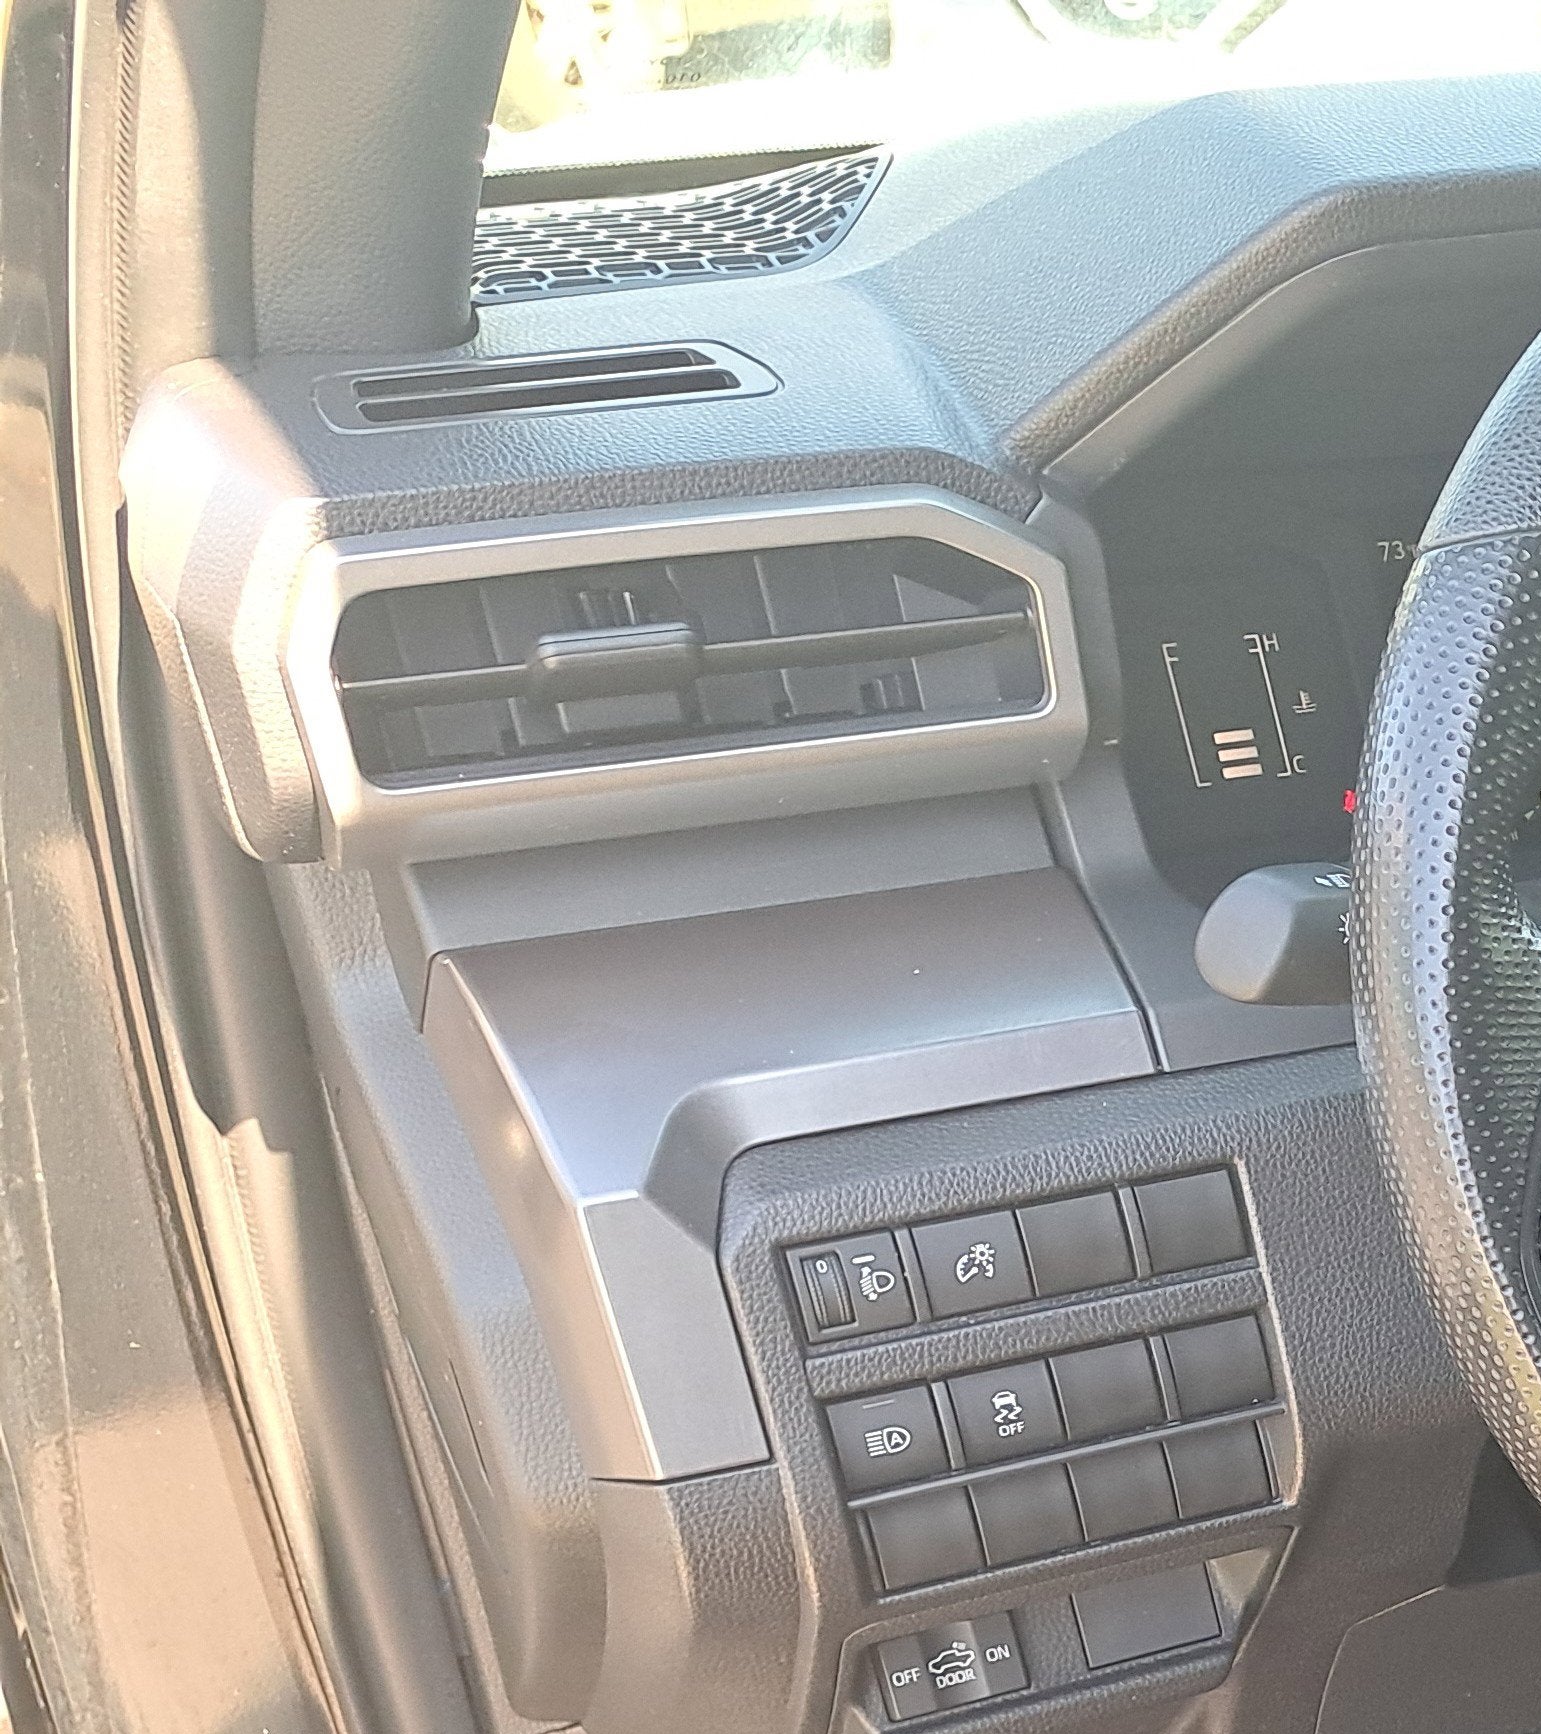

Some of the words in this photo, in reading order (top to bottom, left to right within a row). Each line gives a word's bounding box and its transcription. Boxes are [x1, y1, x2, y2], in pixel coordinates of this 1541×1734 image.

[1263, 633, 1279, 652] H
[1293, 755, 1306, 773] C
[816, 1258, 829, 1274] 0
[997, 1419, 1026, 1437] OFF
[984, 1642, 1011, 1664] ON
[891, 1665, 922, 1689] OFF
[935, 1667, 977, 1689] DOOR
